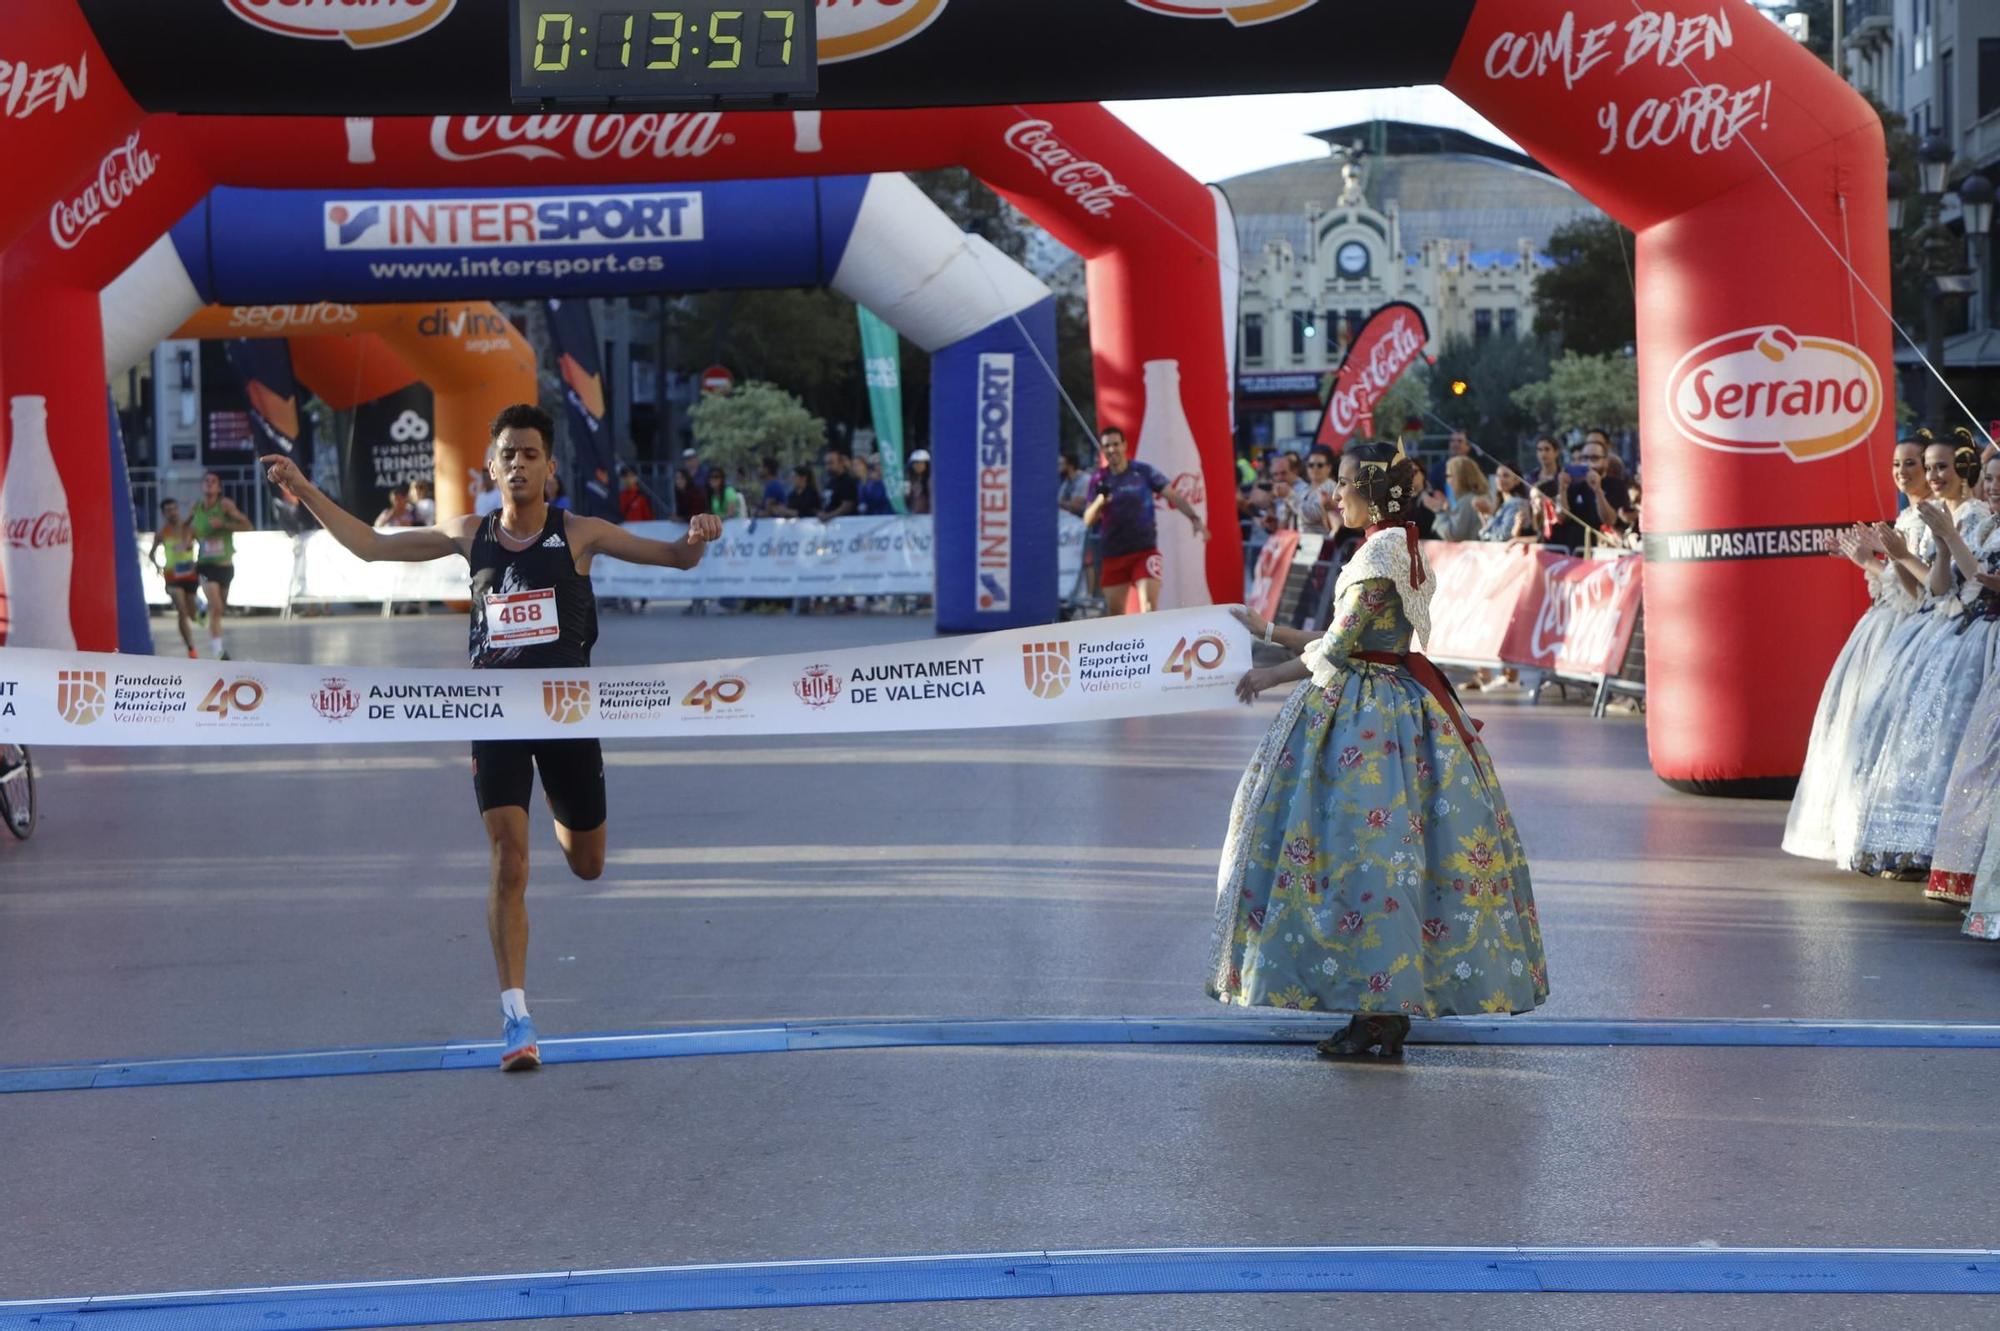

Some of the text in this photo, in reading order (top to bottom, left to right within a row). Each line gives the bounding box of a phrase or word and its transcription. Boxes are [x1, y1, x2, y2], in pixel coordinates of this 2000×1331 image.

[1484, 5, 1733, 90] COME BIEN
[1625, 79, 1772, 155] CORRE!
[389, 198, 690, 245] INTERSPORT
[370, 253, 664, 279] www.intersport.es
[1686, 369, 1869, 421] Serrano
[373, 453, 433, 472] TRINID
[979, 363, 1012, 569] INTERSPORT
[499, 603, 542, 624] 468
[1078, 638, 1145, 654] Fundació
[1079, 653, 1149, 668] Esportiva
[1162, 636, 1226, 681] 40
[114, 674, 183, 686] Fundació
[851, 658, 985, 682] AJUNTAMENT
[1080, 664, 1151, 681] Municipal
[114, 688, 186, 701] Esportiva
[368, 685, 504, 698] AJUNTAMENT
[599, 688, 669, 697] Esportiva
[681, 680, 748, 712] 40
[851, 679, 985, 704] DE VALÈNCIA
[1081, 679, 1142, 693] València
[114, 701, 187, 713] Municipal
[196, 678, 265, 720] 40
[600, 697, 671, 708] Municipal
[368, 701, 504, 719] DE VALÈNCIA
